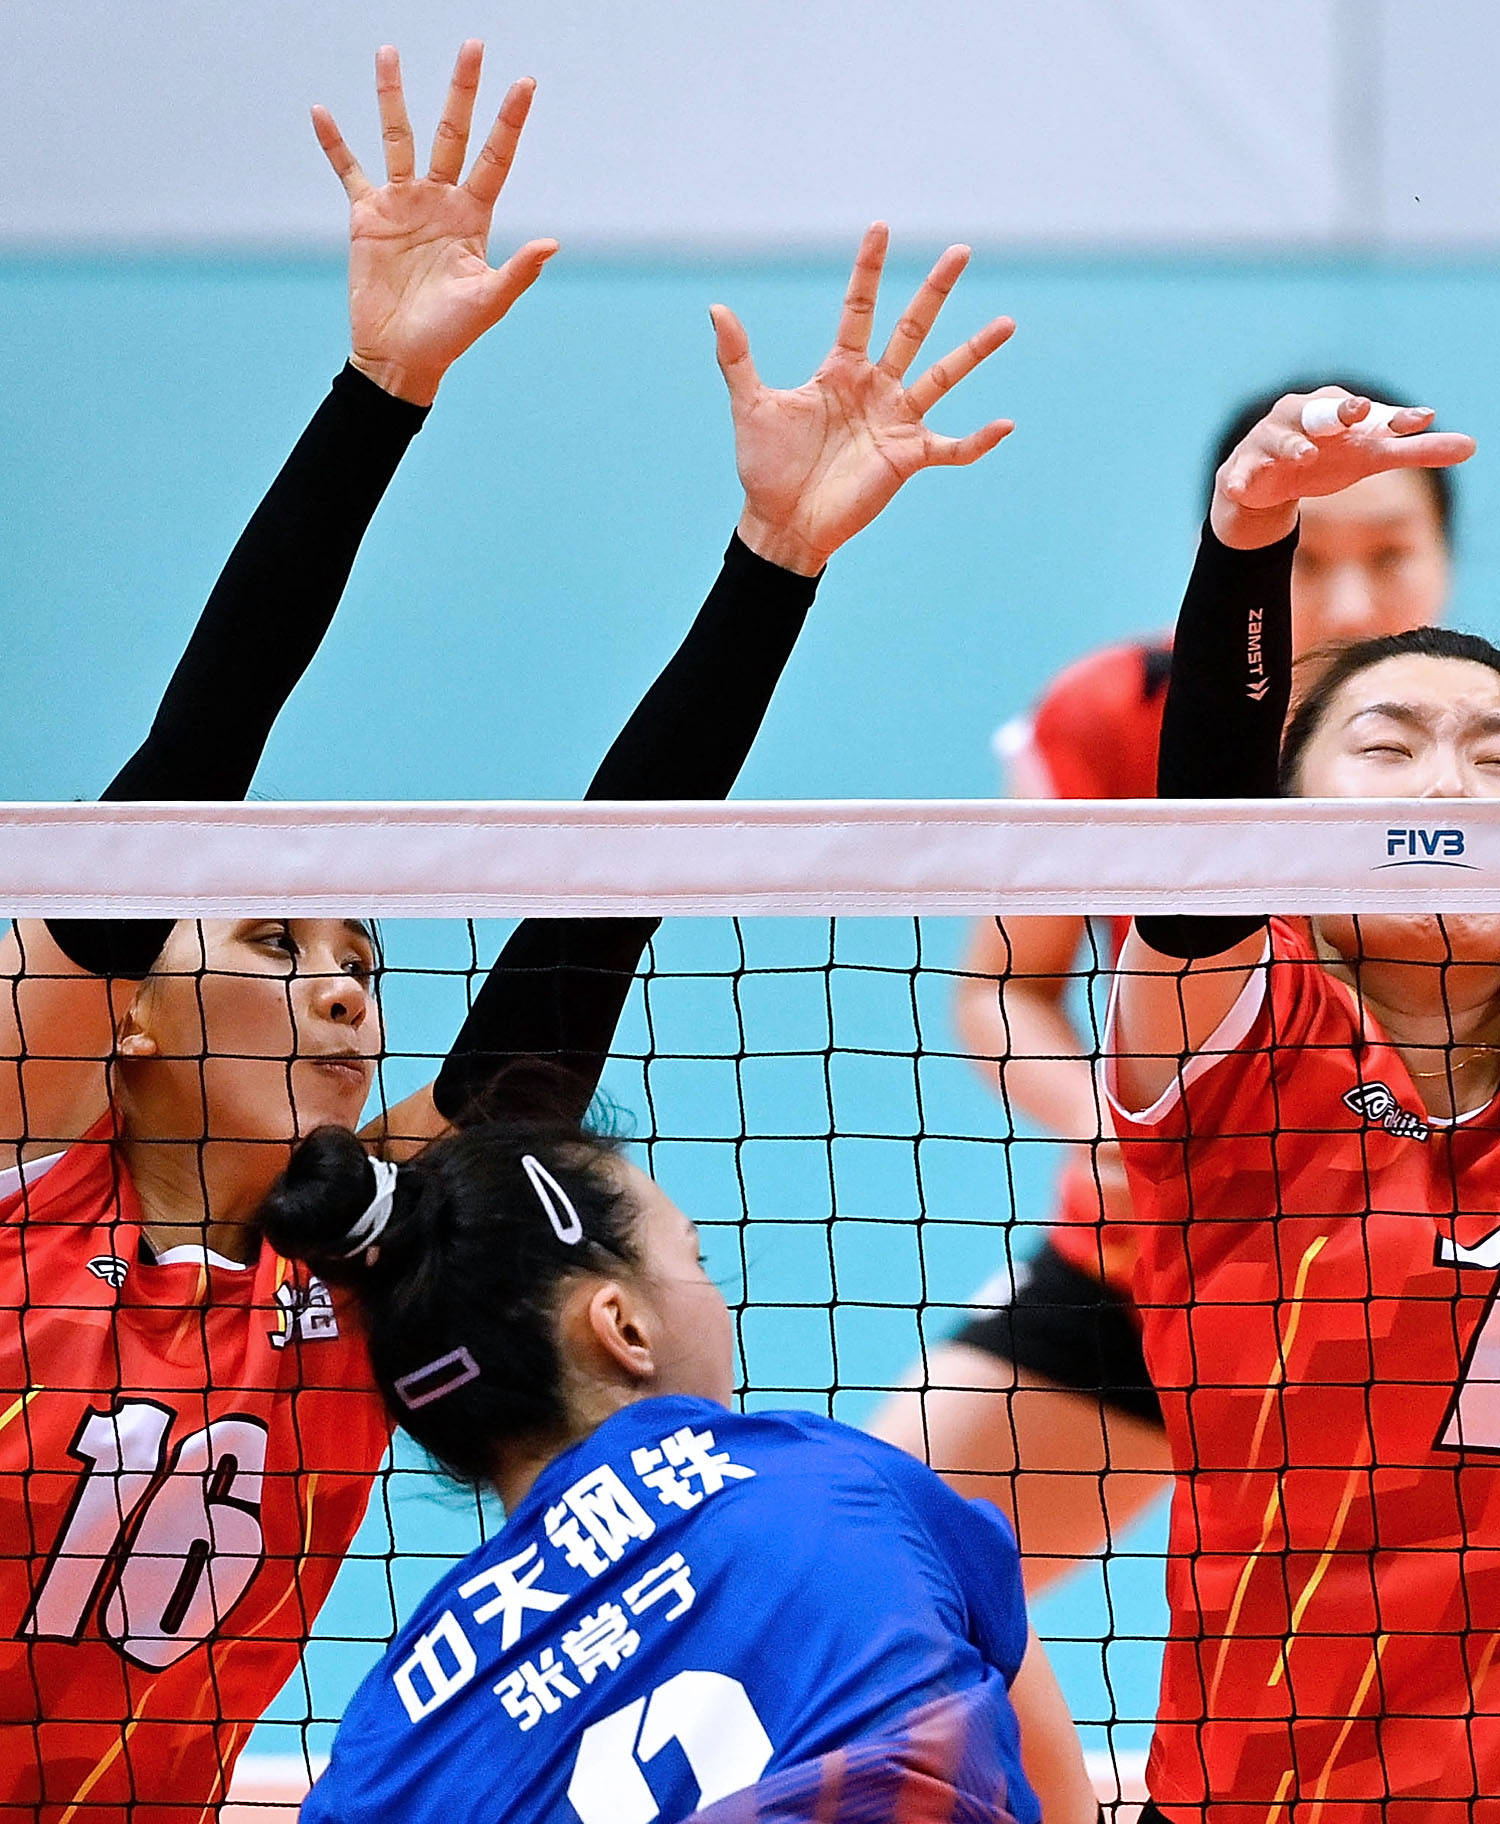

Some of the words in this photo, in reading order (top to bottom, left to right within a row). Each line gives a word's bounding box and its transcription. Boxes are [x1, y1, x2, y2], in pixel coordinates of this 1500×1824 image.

[1387, 829, 1465, 856] FIVB
[18, 1398, 268, 1672] 16
[393, 1426, 757, 1724] 中天钢铁
[492, 1551, 697, 1732] 张常宁
